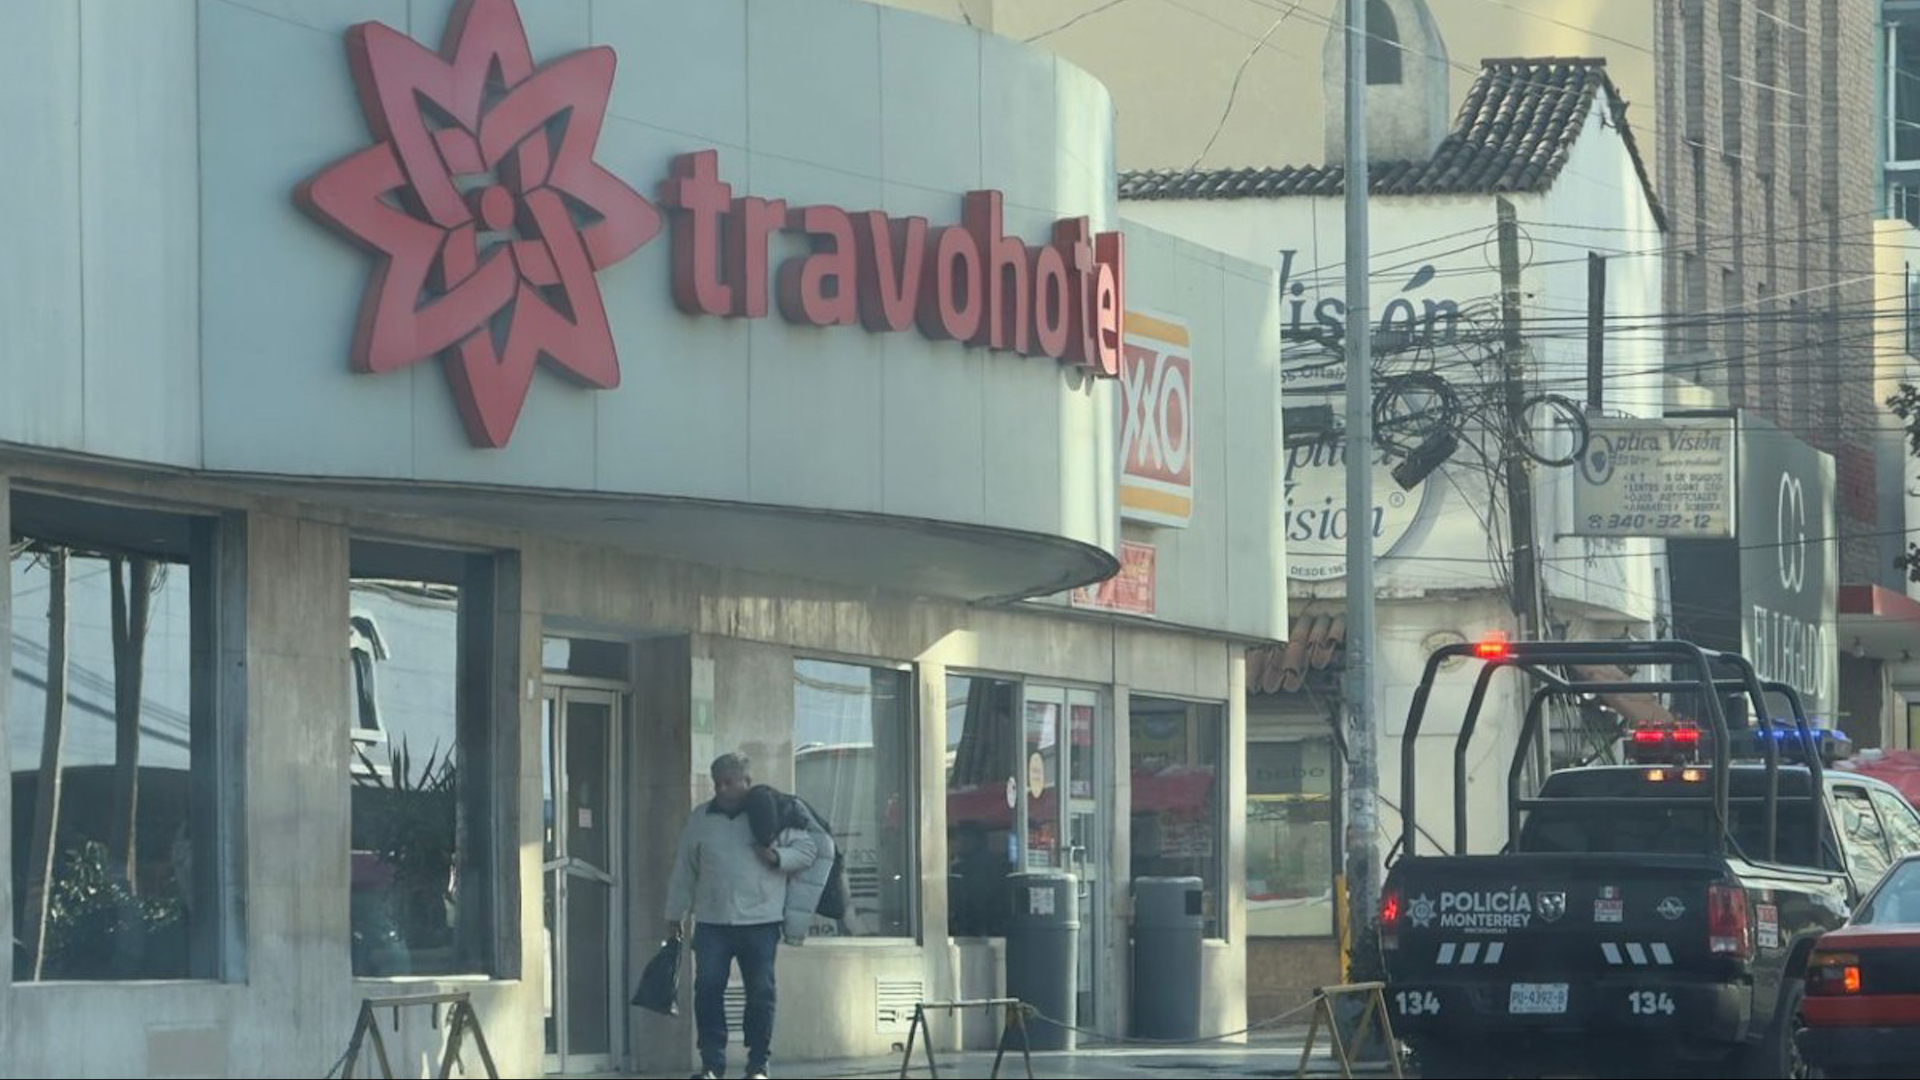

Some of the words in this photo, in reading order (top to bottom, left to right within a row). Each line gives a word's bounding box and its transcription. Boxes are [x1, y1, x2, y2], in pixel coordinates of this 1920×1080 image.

[661, 149, 1125, 380] travohotel
[1120, 347, 1188, 476] XXO
[1290, 565, 1329, 577] DESDE
[1773, 611, 1827, 699] LEGADO
[1440, 886, 1532, 912] POLICÍA
[1440, 914, 1531, 927] MONTERREY
[1396, 991, 1440, 1015] 134
[1629, 991, 1675, 1015] 134
